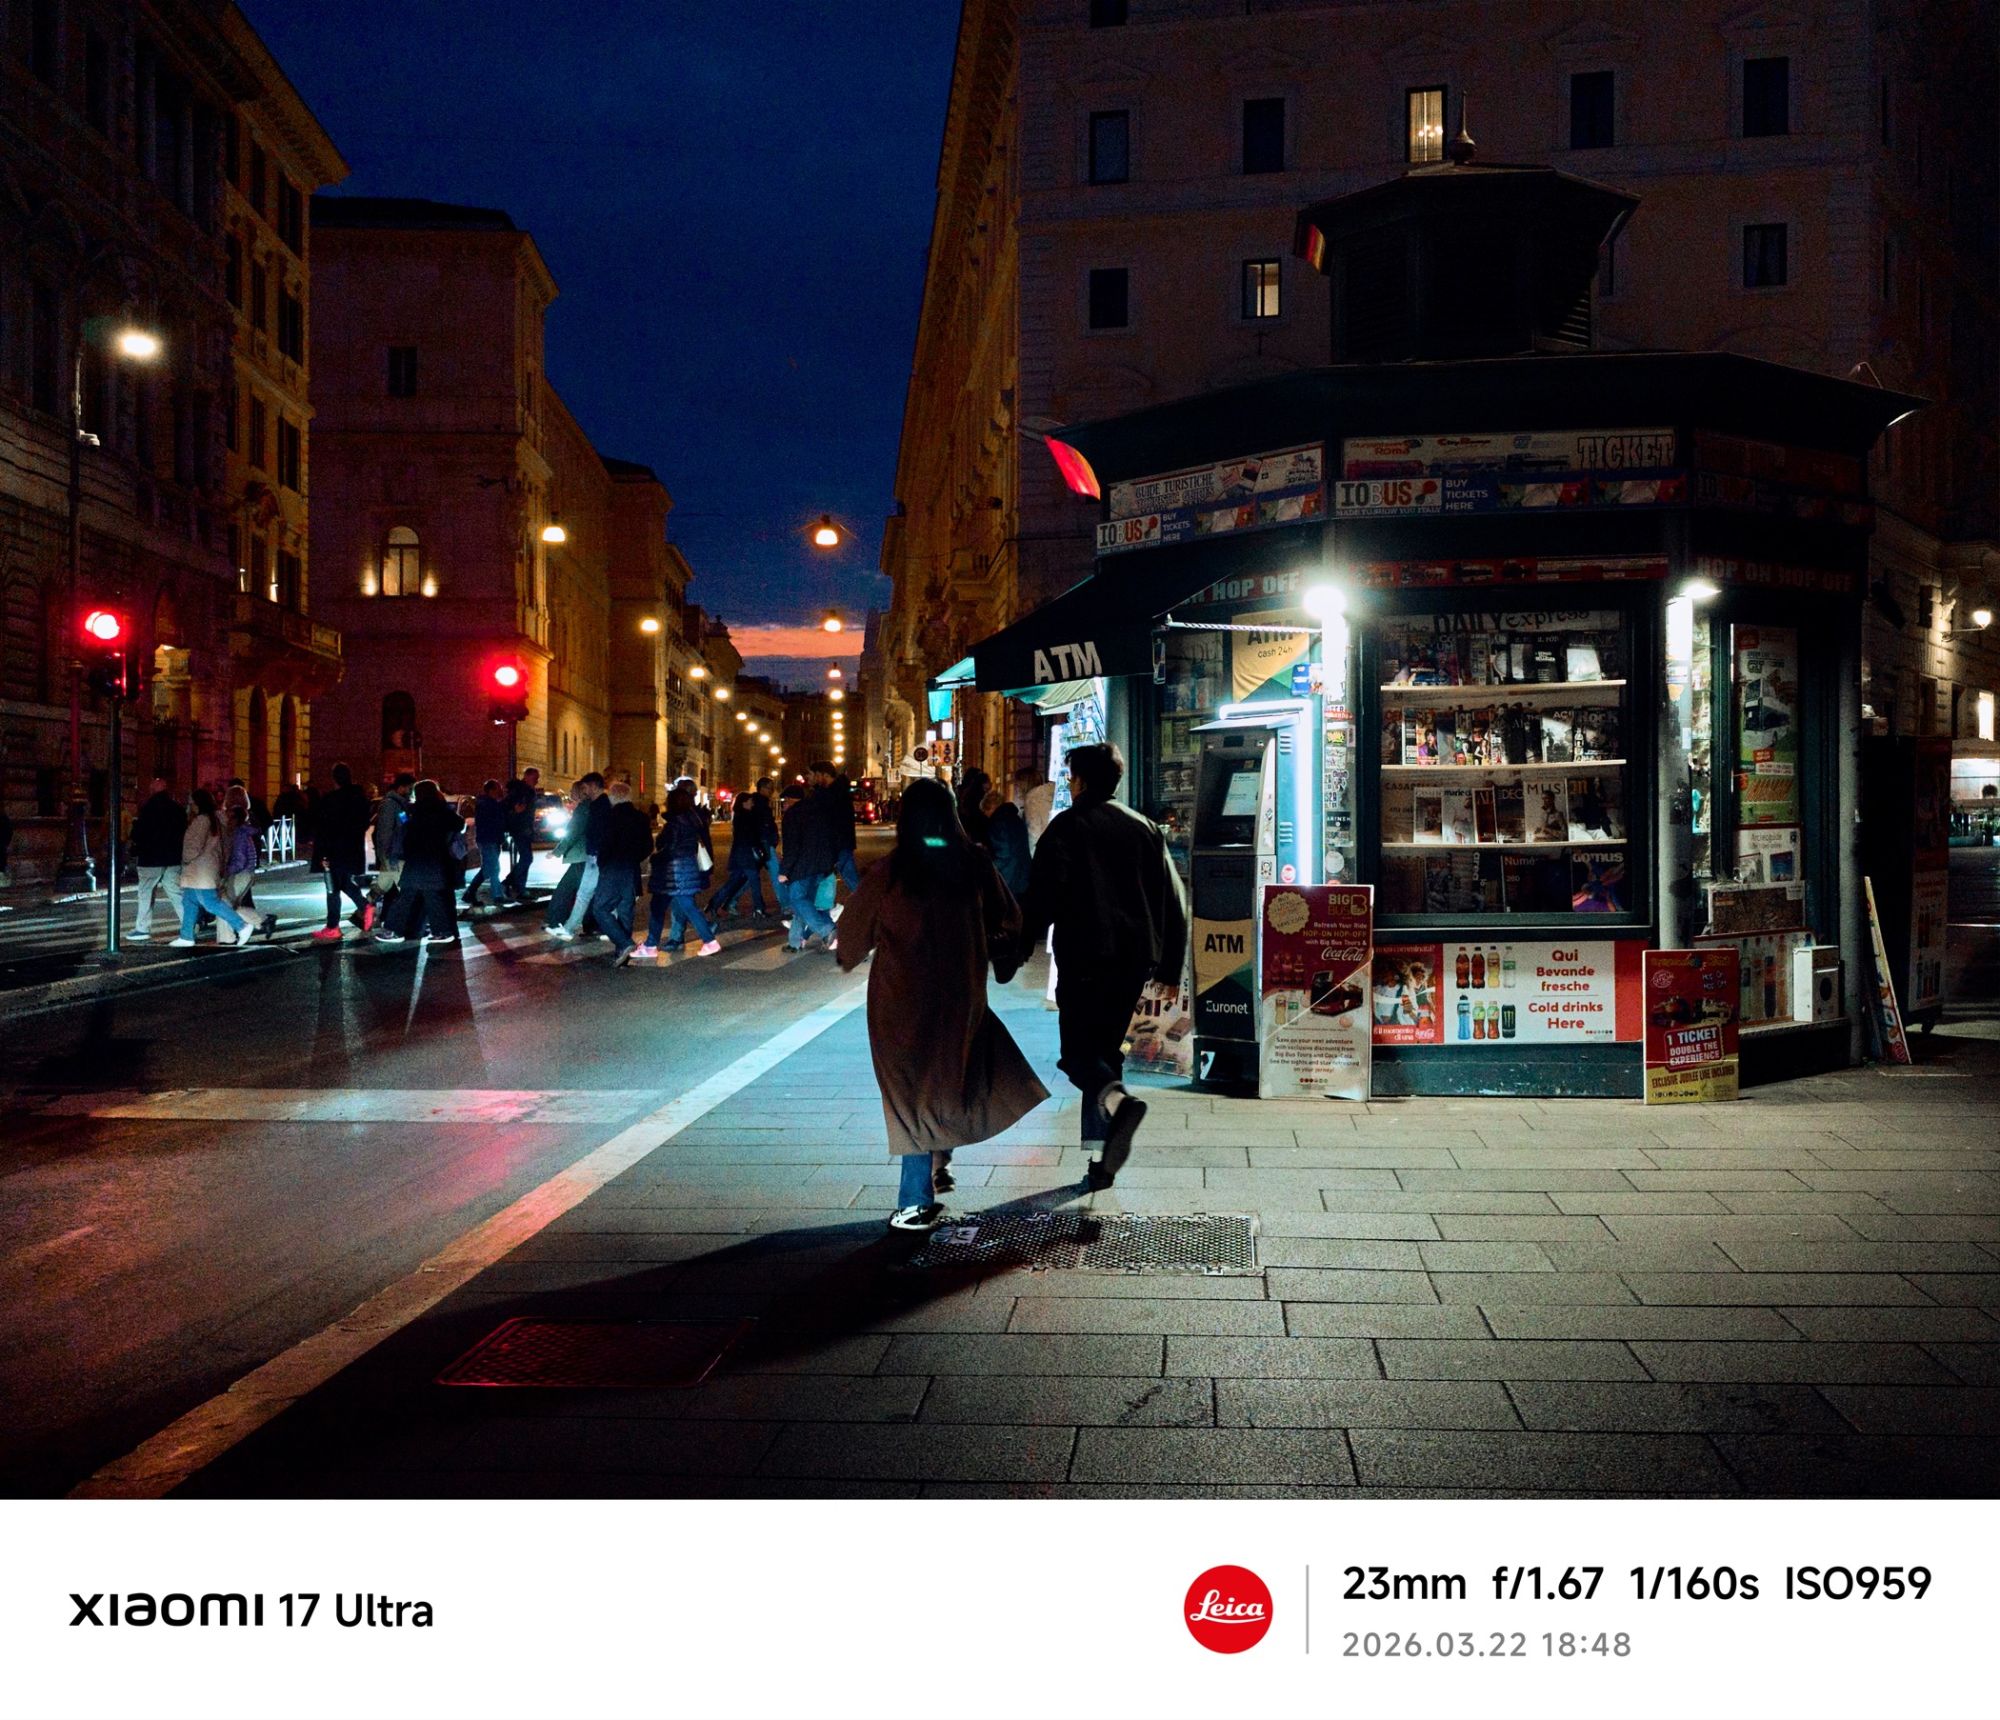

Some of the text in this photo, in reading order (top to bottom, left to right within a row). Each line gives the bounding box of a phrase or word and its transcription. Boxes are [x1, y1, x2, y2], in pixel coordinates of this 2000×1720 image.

[1577, 434, 1673, 471] TICKET
[1135, 472, 1215, 499] GUIDE TURISTICHE
[1445, 479, 1468, 489] BUY
[1340, 481, 1412, 507] IOBUS
[1445, 489, 1489, 499] TICKETS
[1445, 501, 1475, 511] HERE
[1163, 511, 1177, 523] BUY
[1163, 520, 1191, 532] TICKETS
[1099, 519, 1142, 547] IOBUS
[1163, 532, 1181, 543] HERE
[1212, 578, 1255, 602] HOP
[1263, 571, 1300, 595] OFF
[1433, 611, 1501, 634] DAILY
[1506, 609, 1590, 630] express
[1247, 620, 1294, 646] ATM
[1258, 646, 1293, 659] cash 24h
[1034, 641, 1103, 685] ATM
[1527, 783, 1566, 796] MUS
[1328, 893, 1350, 906] BIG
[1327, 905, 1350, 916] BUS
[1313, 922, 1338, 930] Refresh
[1353, 922, 1368, 930] Ride
[1204, 933, 1244, 954] ATM
[1319, 939, 1330, 947] Big
[1331, 939, 1343, 947] Bus
[1552, 948, 1579, 963] Qui
[1536, 965, 1595, 978] Bevande
[1541, 980, 1590, 992] fresche
[1528, 1001, 1604, 1013] Cold drinks
[1547, 1017, 1585, 1029] Here
[1383, 1027, 1414, 1035] momento
[1666, 1027, 1717, 1046] 1 TICKET
[1669, 1041, 1718, 1057] DOUBLE THE
[1669, 1052, 1721, 1067] EXPERIENCE
[1651, 1075, 1678, 1089] EXCLUSIVE
[1699, 1069, 1710, 1081] LINE
